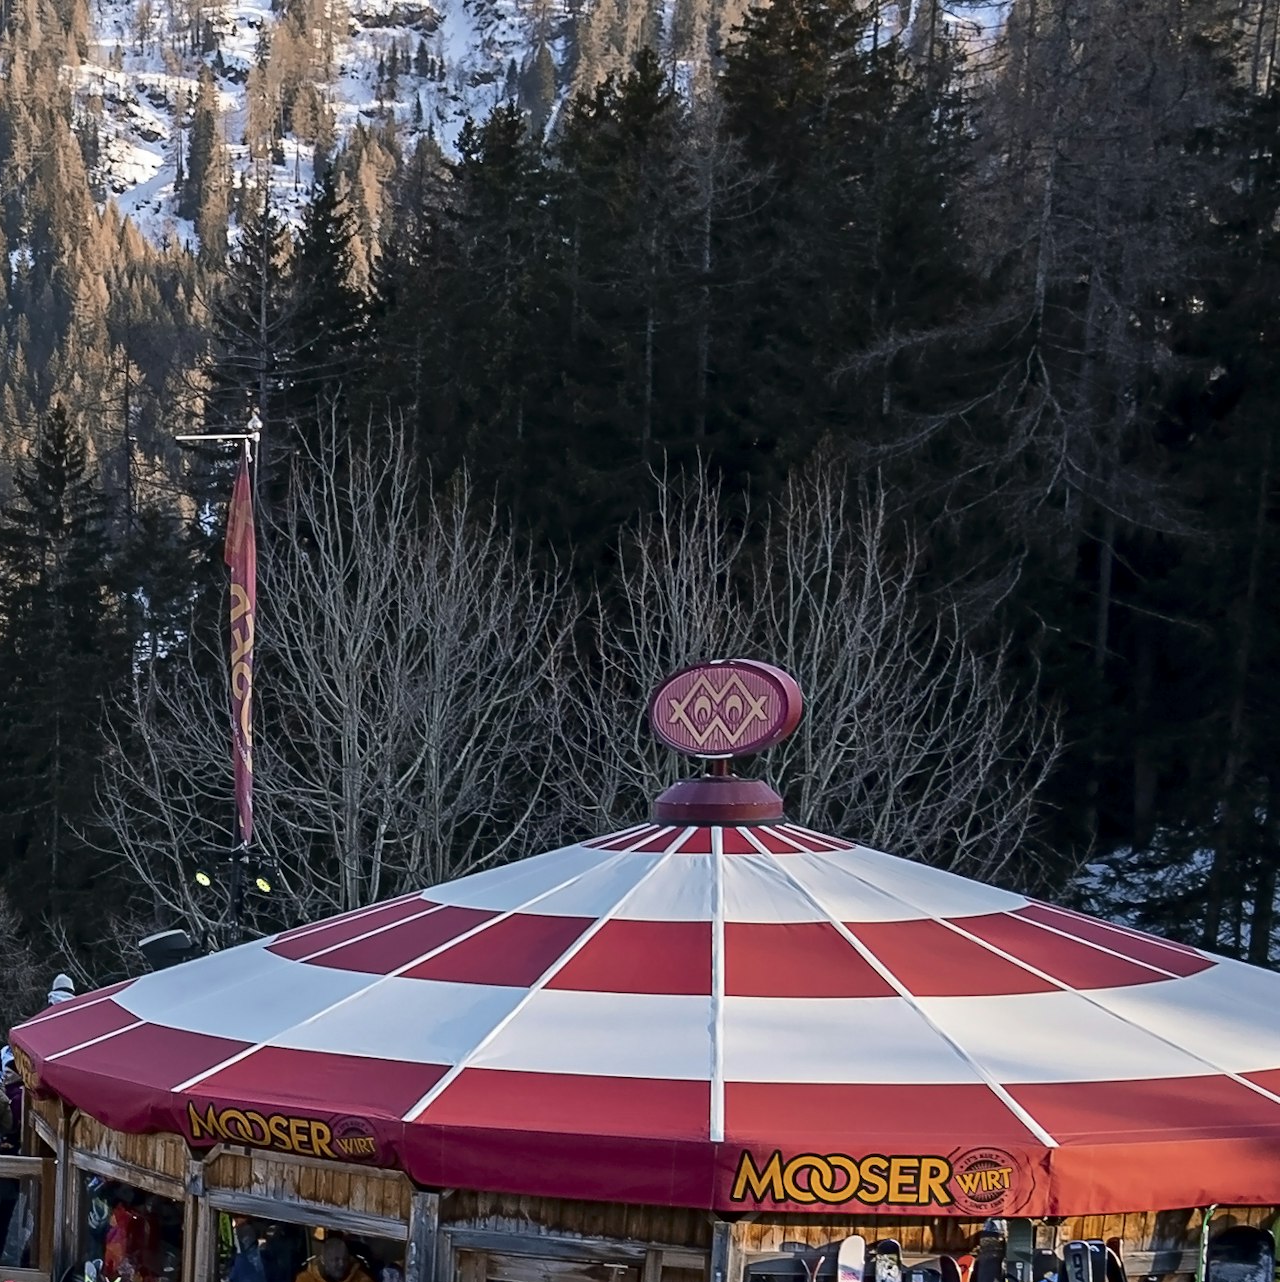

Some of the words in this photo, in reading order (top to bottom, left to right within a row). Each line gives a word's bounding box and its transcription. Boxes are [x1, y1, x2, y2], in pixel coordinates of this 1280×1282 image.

[188, 1101, 339, 1158] MOOSER
[336, 1136, 376, 1154] WIRT
[732, 1151, 952, 1205] MOOSER
[954, 1167, 1014, 1195] WIRT
